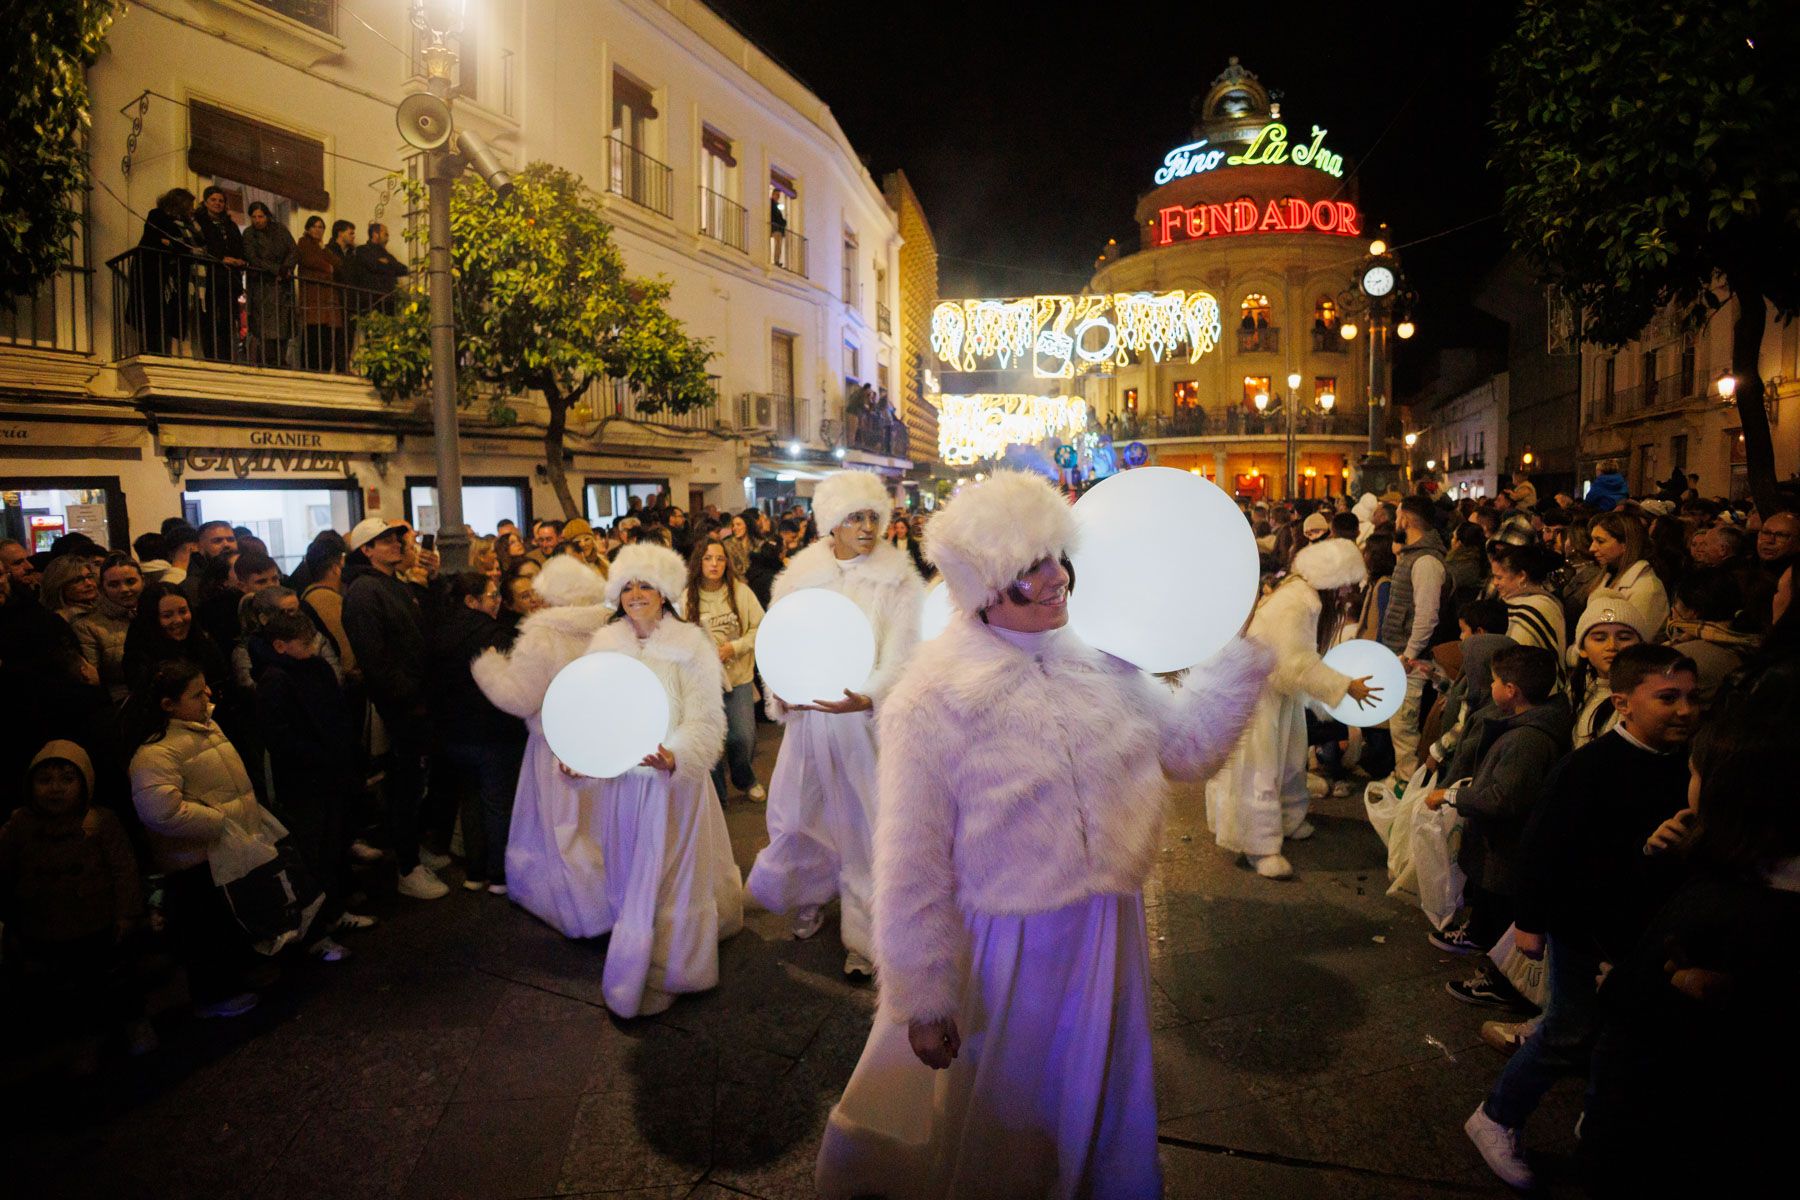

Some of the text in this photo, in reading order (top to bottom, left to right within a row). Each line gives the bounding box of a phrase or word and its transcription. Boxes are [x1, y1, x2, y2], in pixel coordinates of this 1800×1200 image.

[1154, 138, 1225, 186] Fino
[1227, 122, 1289, 166] La
[1158, 197, 1361, 246] FUNDADOR
[250, 431, 322, 447] GRANIER
[186, 448, 357, 479] GRANIER
